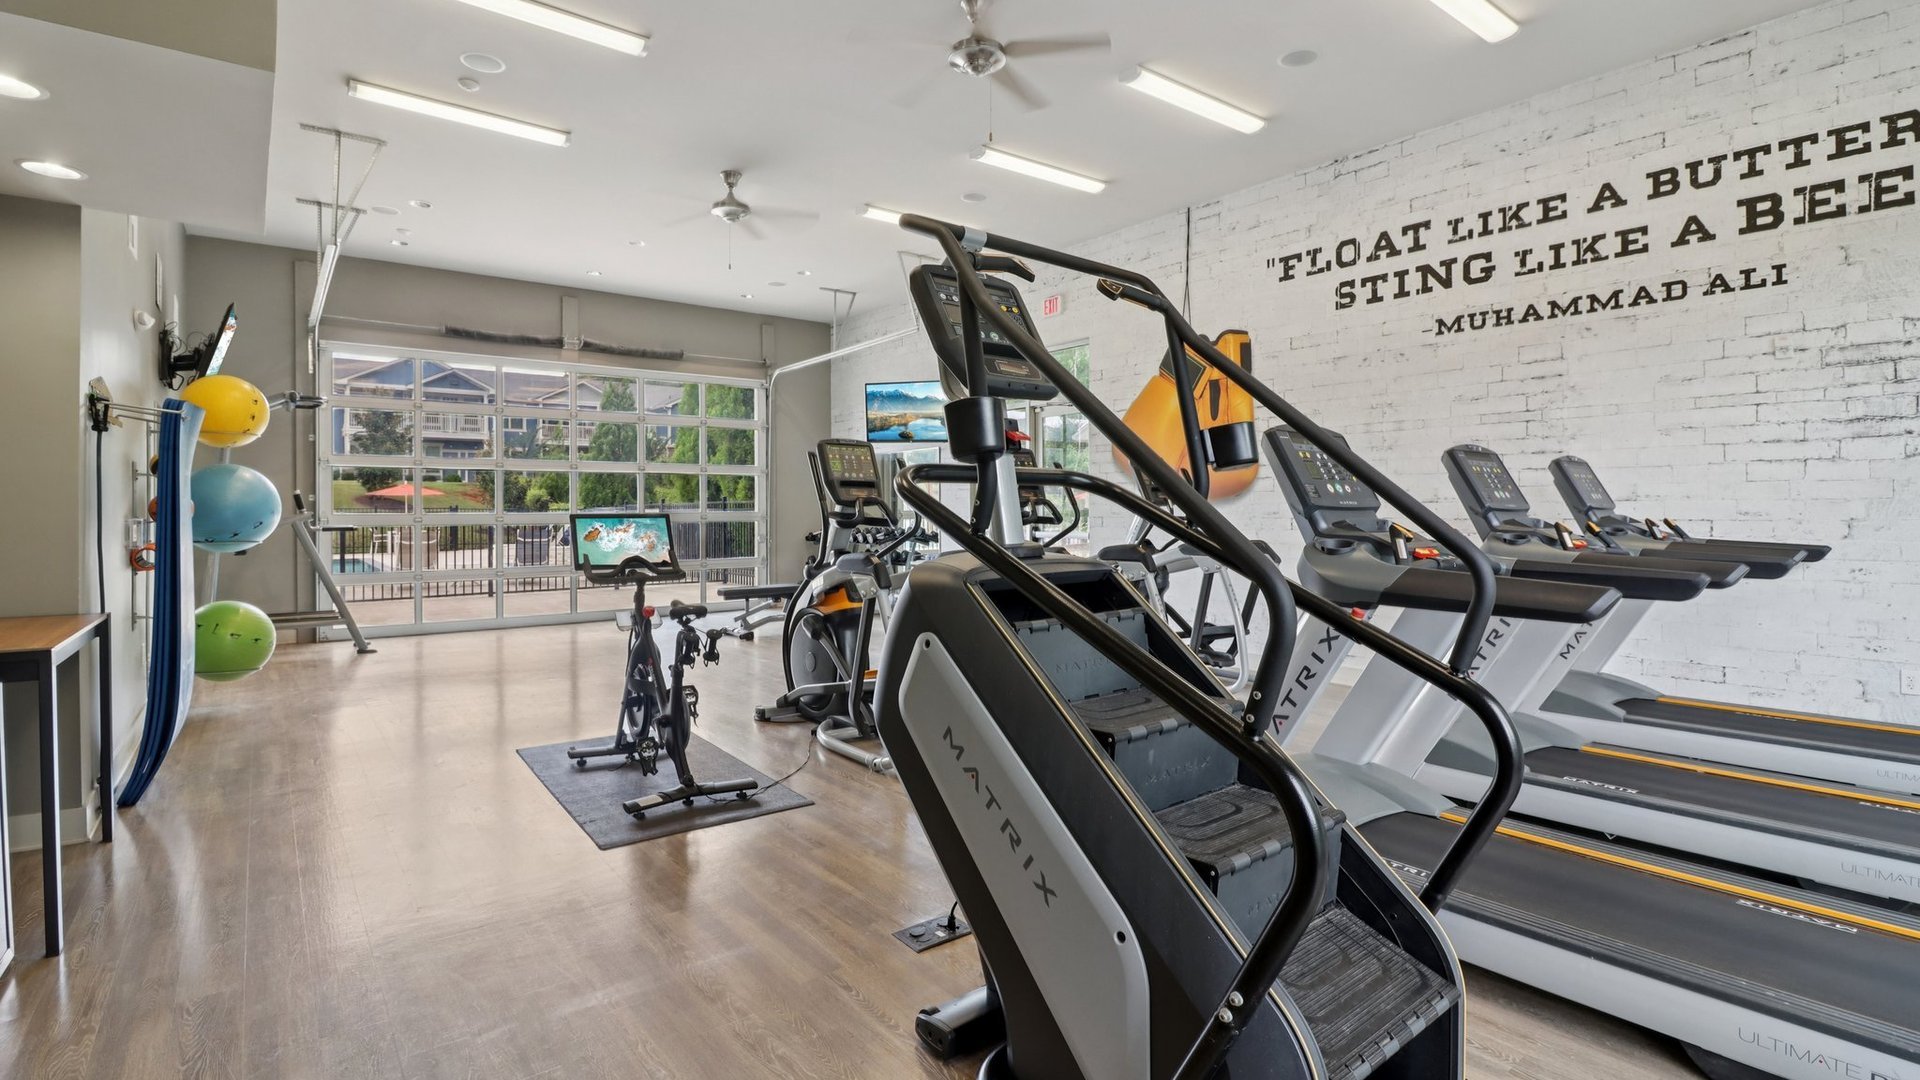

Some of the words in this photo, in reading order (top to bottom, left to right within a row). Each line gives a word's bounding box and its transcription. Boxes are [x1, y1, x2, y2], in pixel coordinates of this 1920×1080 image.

[1267, 220, 1431, 282] "FLOAT
[1448, 193, 1567, 244] LIKE
[1588, 183, 1627, 213] A
[1335, 252, 1496, 310] STING
[1514, 226, 1648, 276] LIKE
[1670, 215, 1716, 247] A
[1737, 165, 1915, 235] BEE
[1044, 297, 1058, 316] EXIT
[1703, 263, 1788, 296] ALI
[1272, 627, 1341, 735] ATRIX
[1467, 618, 1511, 679] ATRI
[943, 725, 1058, 908] MATRIX
[1738, 1027, 1863, 1080] ULTIMATE
